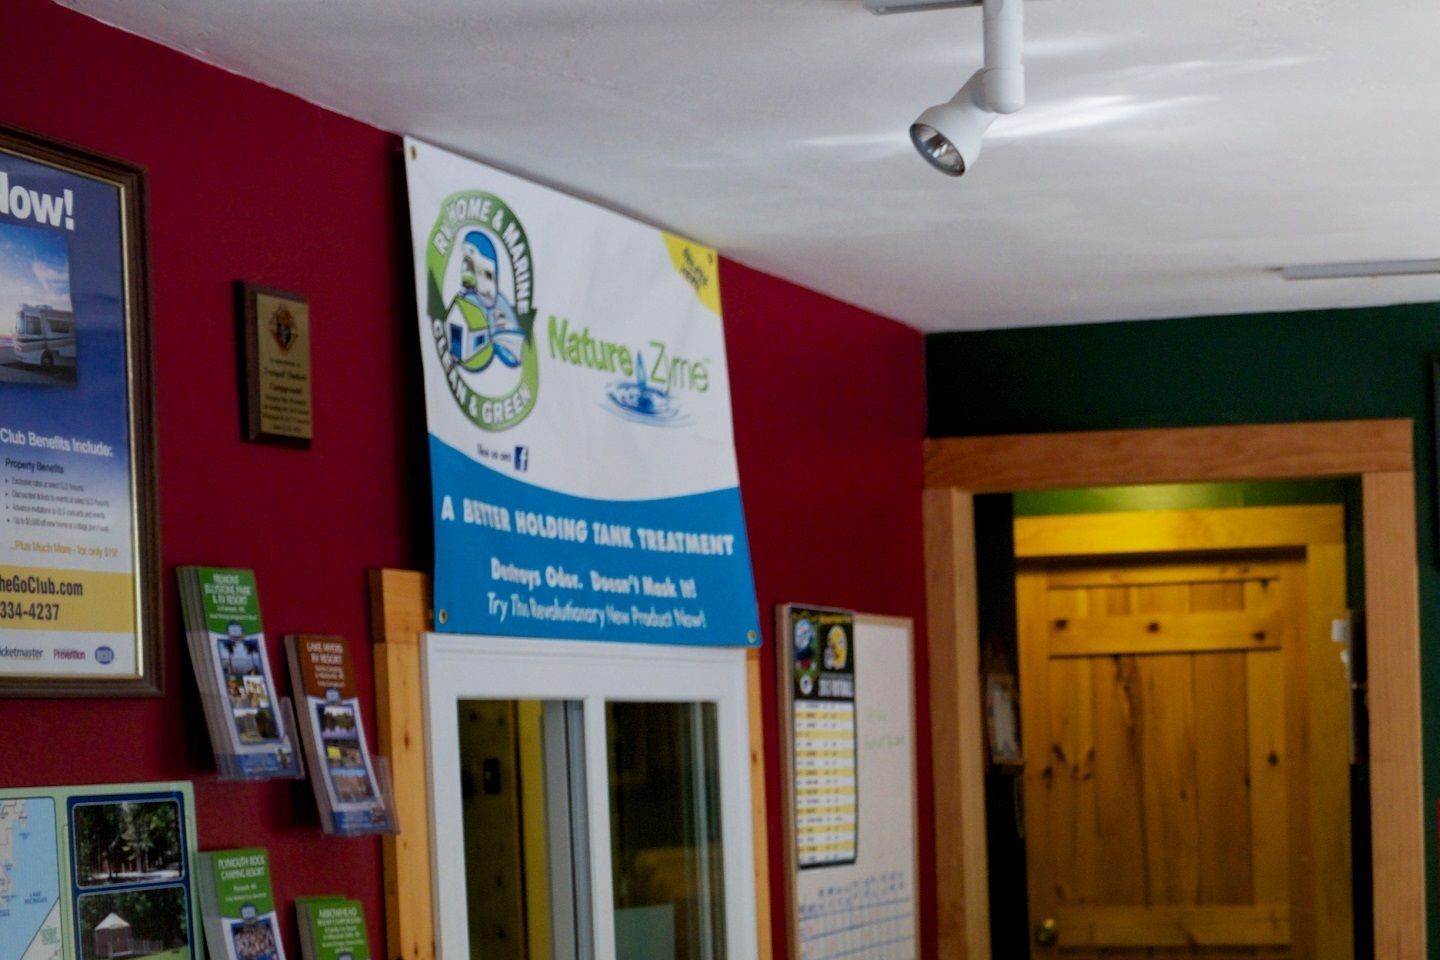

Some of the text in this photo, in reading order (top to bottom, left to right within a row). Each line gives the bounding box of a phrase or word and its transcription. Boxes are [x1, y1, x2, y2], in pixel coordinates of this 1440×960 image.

[447, 197, 491, 223] HOME
[492, 208, 505, 232] &
[502, 221, 531, 315] MARINE
[547, 314, 633, 377] Nature
[482, 383, 532, 427] GREEN
[0, 428, 113, 457] Club Benefits Include:
[5, 458, 65, 474] Property Benefits
[441, 494, 735, 556] A BETTER HOLDING TANK TREATMENT
[490, 556, 541, 592] Destroys
[545, 565, 583, 590] Odor.
[590, 570, 640, 594] Doesn't
[642, 576, 677, 598] Mask
[487, 592, 508, 623] Try
[529, 597, 605, 629] Revolutionary
[631, 604, 673, 628] Product
[673, 608, 707, 629] Now!
[53, 647, 86, 660] Prevention
